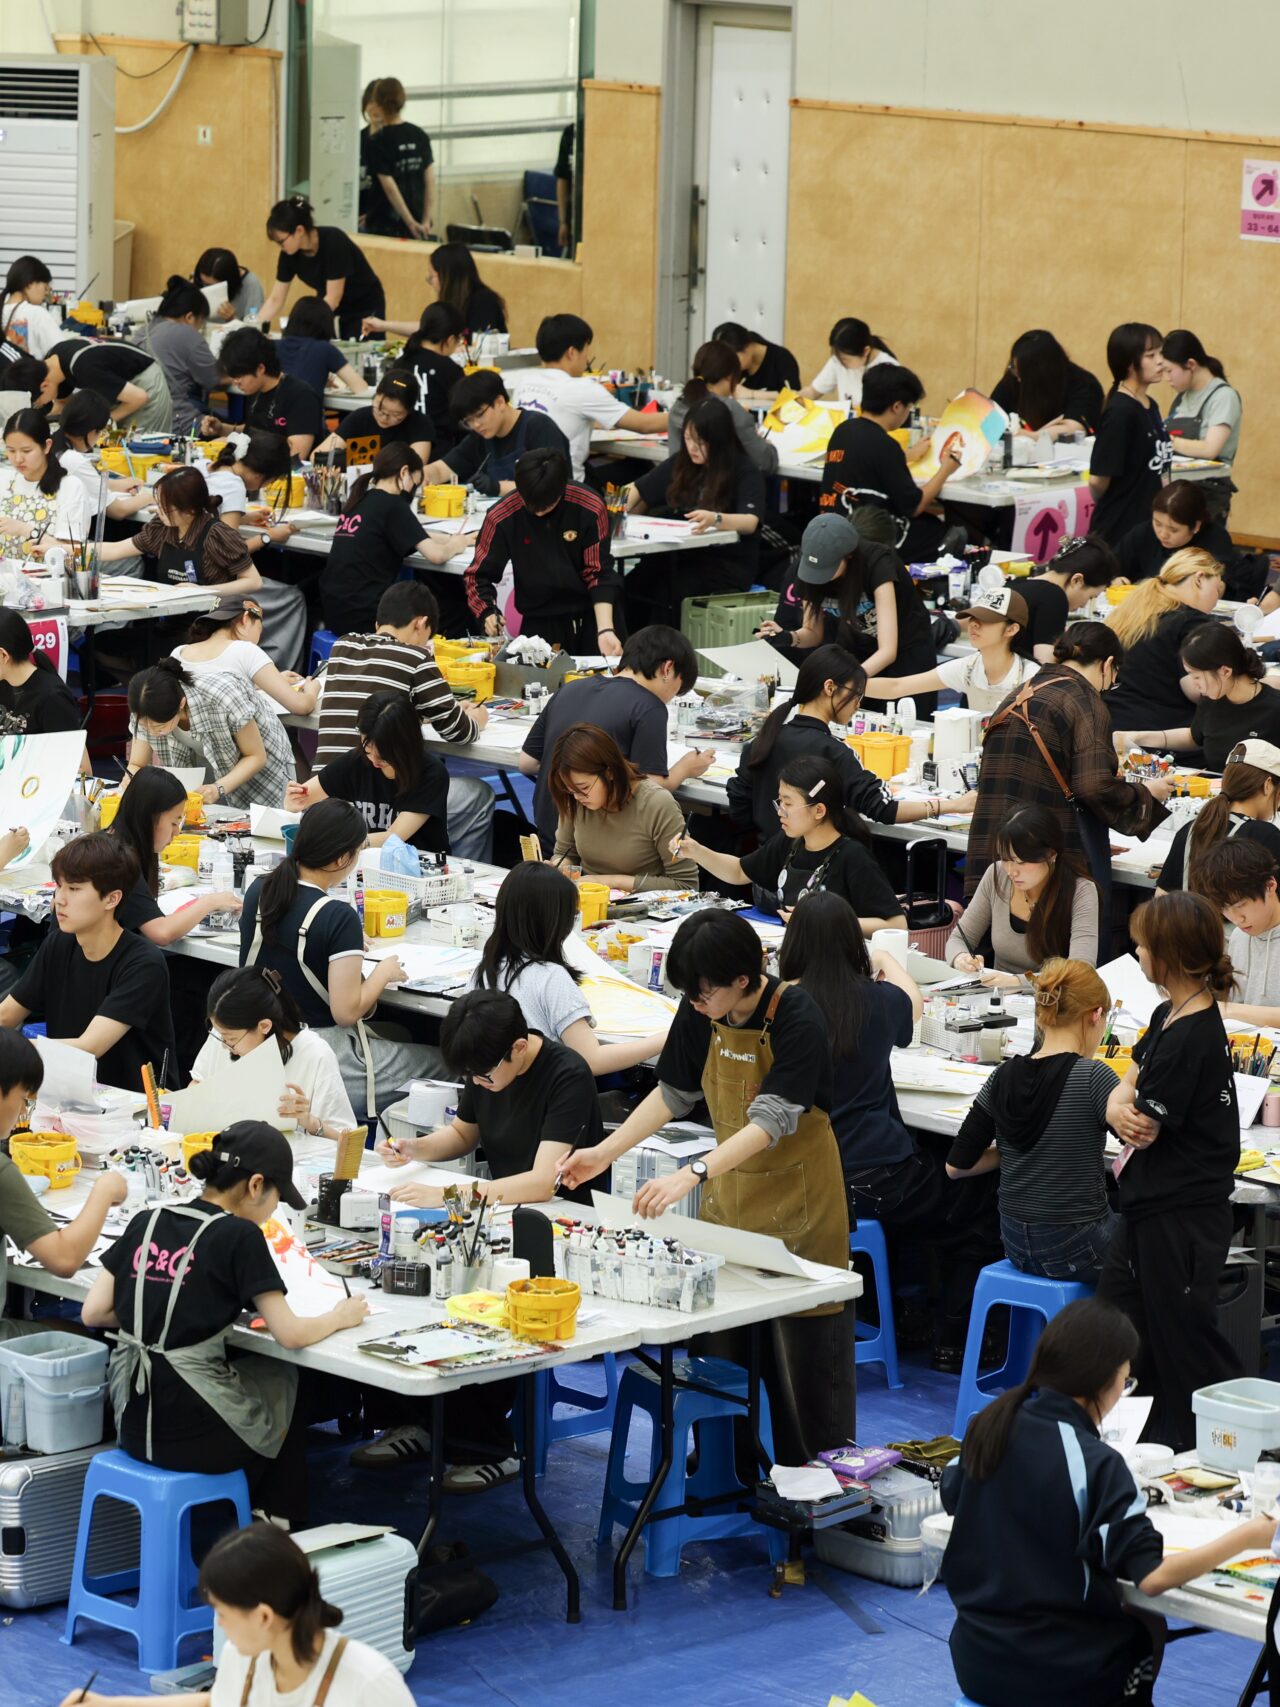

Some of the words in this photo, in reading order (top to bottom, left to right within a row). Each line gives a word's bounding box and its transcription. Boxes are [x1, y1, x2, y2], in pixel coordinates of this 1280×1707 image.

[1247, 222, 1258, 232] 33
[1267, 224, 1279, 233] 64
[335, 513, 362, 534] C&C
[31, 631, 57, 651] 29
[132, 1241, 195, 1278] C&C
